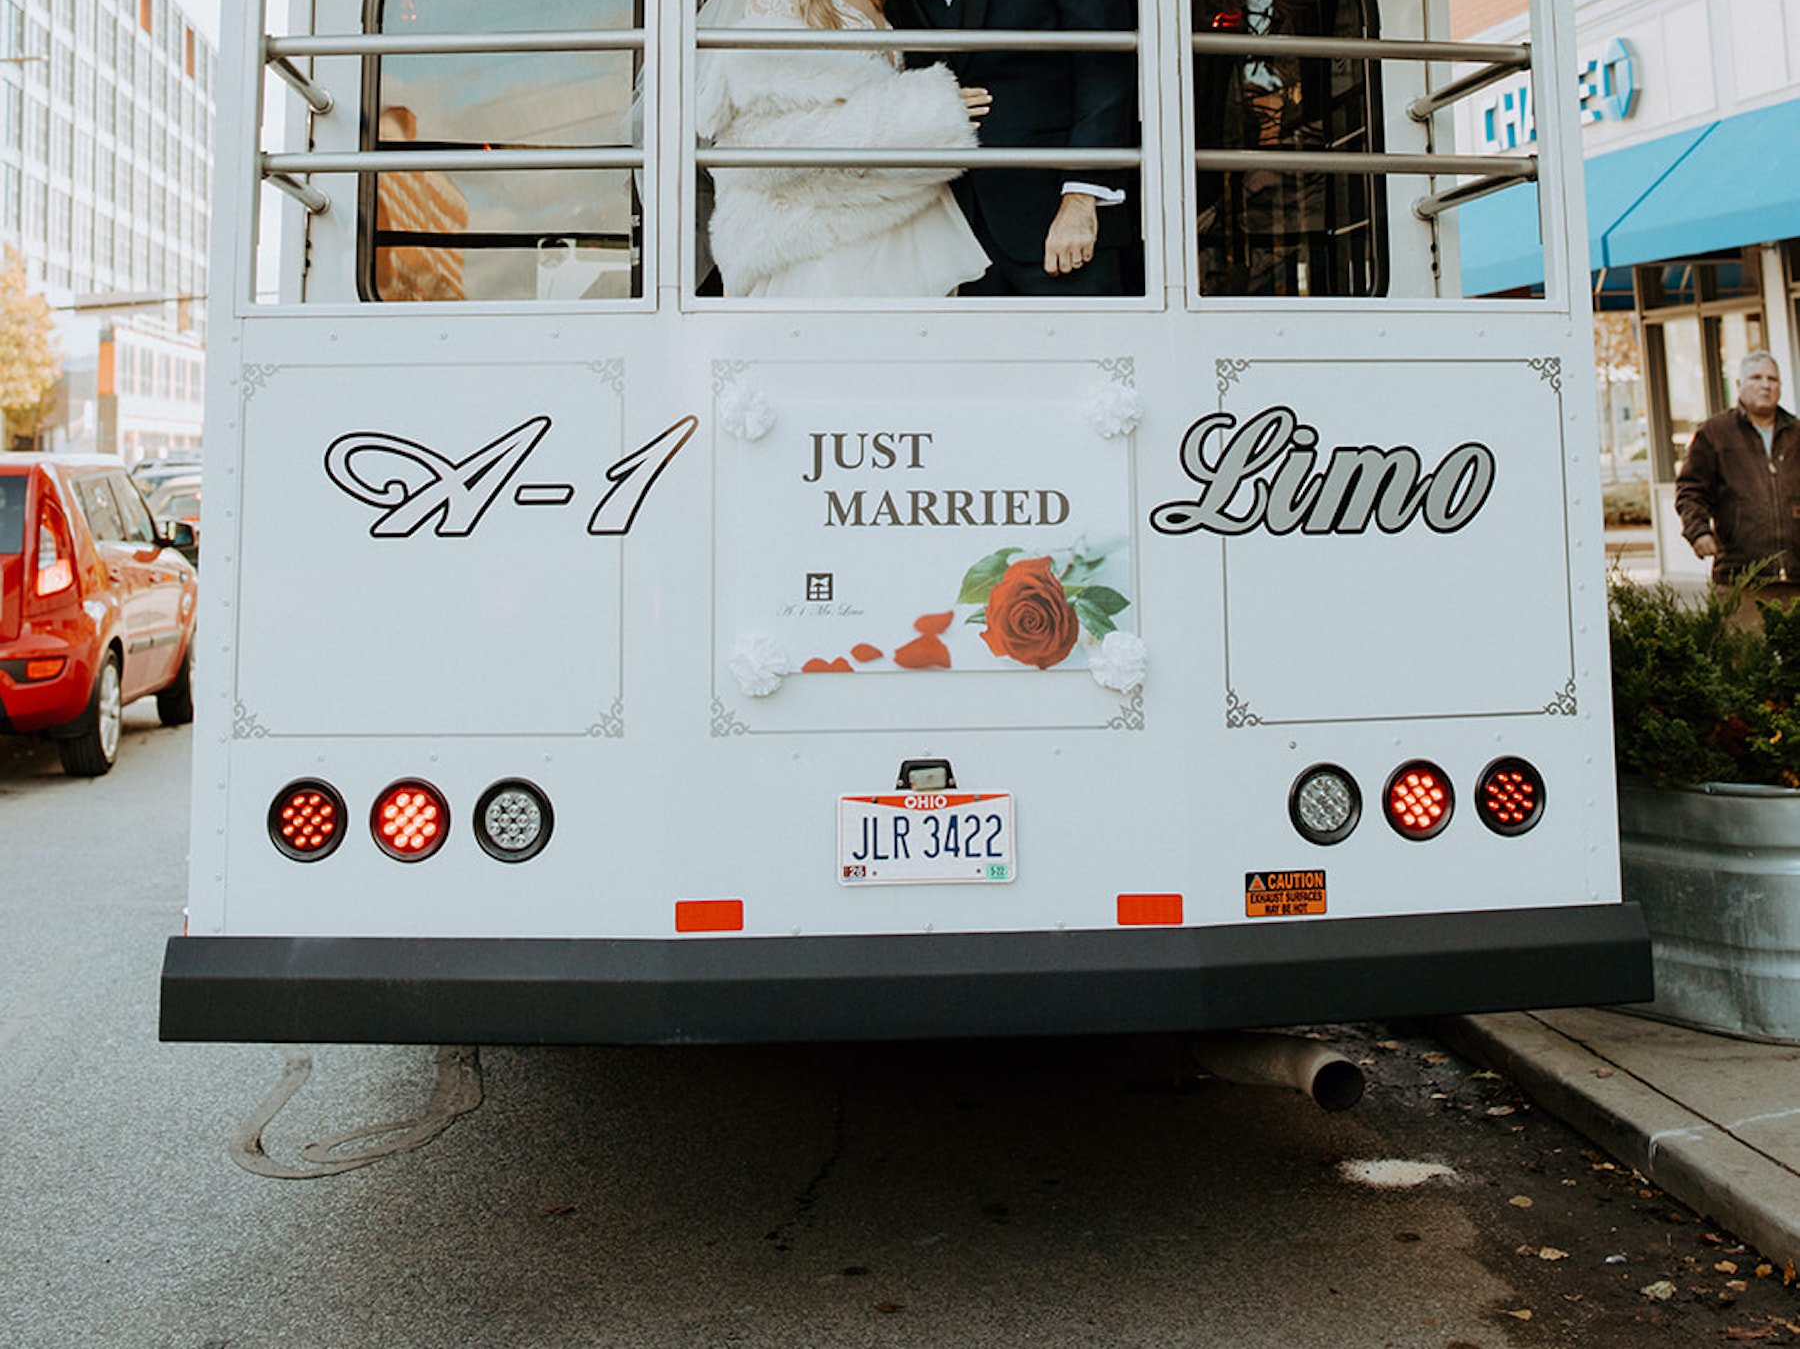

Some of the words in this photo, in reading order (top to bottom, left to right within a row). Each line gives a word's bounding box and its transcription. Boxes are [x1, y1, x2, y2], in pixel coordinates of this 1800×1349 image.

[802, 432, 933, 483] JUST
[324, 415, 698, 538] A-1
[1150, 405, 1496, 537] Limo
[823, 490, 1070, 527] MARRIED
[904, 795, 948, 809] OHIO
[852, 815, 910, 860] JLR
[923, 813, 1002, 858] 3422
[1267, 872, 1324, 890] CAUTION
[1250, 891, 1284, 904] EXHAUST
[1286, 890, 1322, 902] SURFACES
[1265, 904, 1279, 914] MAY
[1281, 903, 1291, 914] BE
[1294, 902, 1308, 913] HOT
